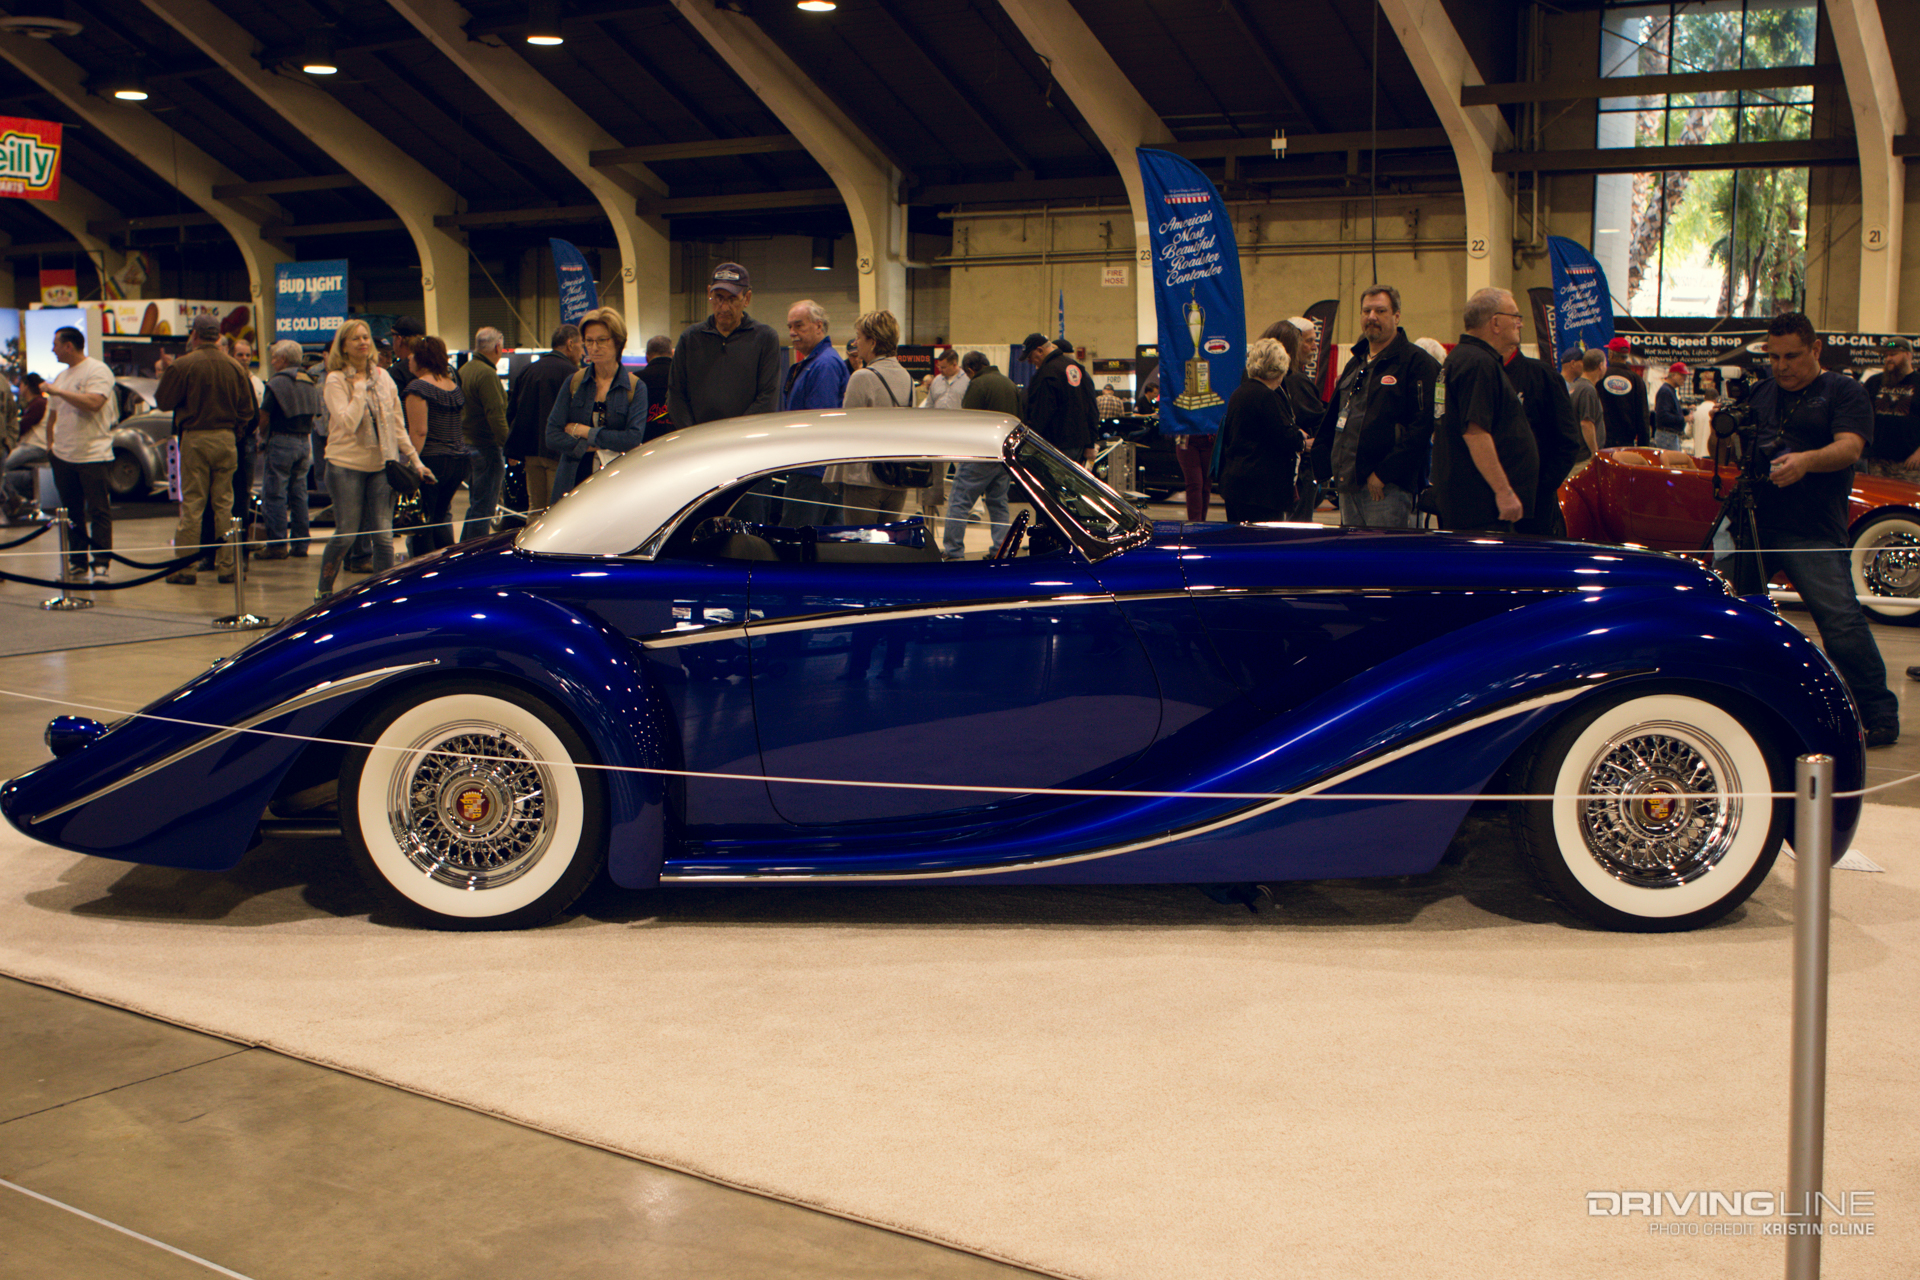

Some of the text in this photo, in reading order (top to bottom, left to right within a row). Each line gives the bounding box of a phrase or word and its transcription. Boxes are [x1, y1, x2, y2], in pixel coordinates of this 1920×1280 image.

[1159, 209, 1213, 234] America's
[1173, 226, 1205, 244] Most
[1869, 230, 1881, 243] 21
[1159, 234, 1216, 261] Beautiful
[1471, 240, 1485, 251] 22
[1140, 251, 1151, 260] 23
[860, 259, 870, 268] 24
[1167, 252, 1220, 273] Roadster
[624, 268, 633, 277] 25
[1166, 263, 1223, 287] Contender
[279, 276, 343, 293] BUD LIGHT
[277, 318, 292, 331] ICE
[293, 317, 318, 331] COLD
[1624, 335, 1667, 345] SO-CAL
[1670, 336, 1707, 348] Speed
[1710, 336, 1742, 347] Shop
[1828, 335, 1876, 346] SO-CAL
